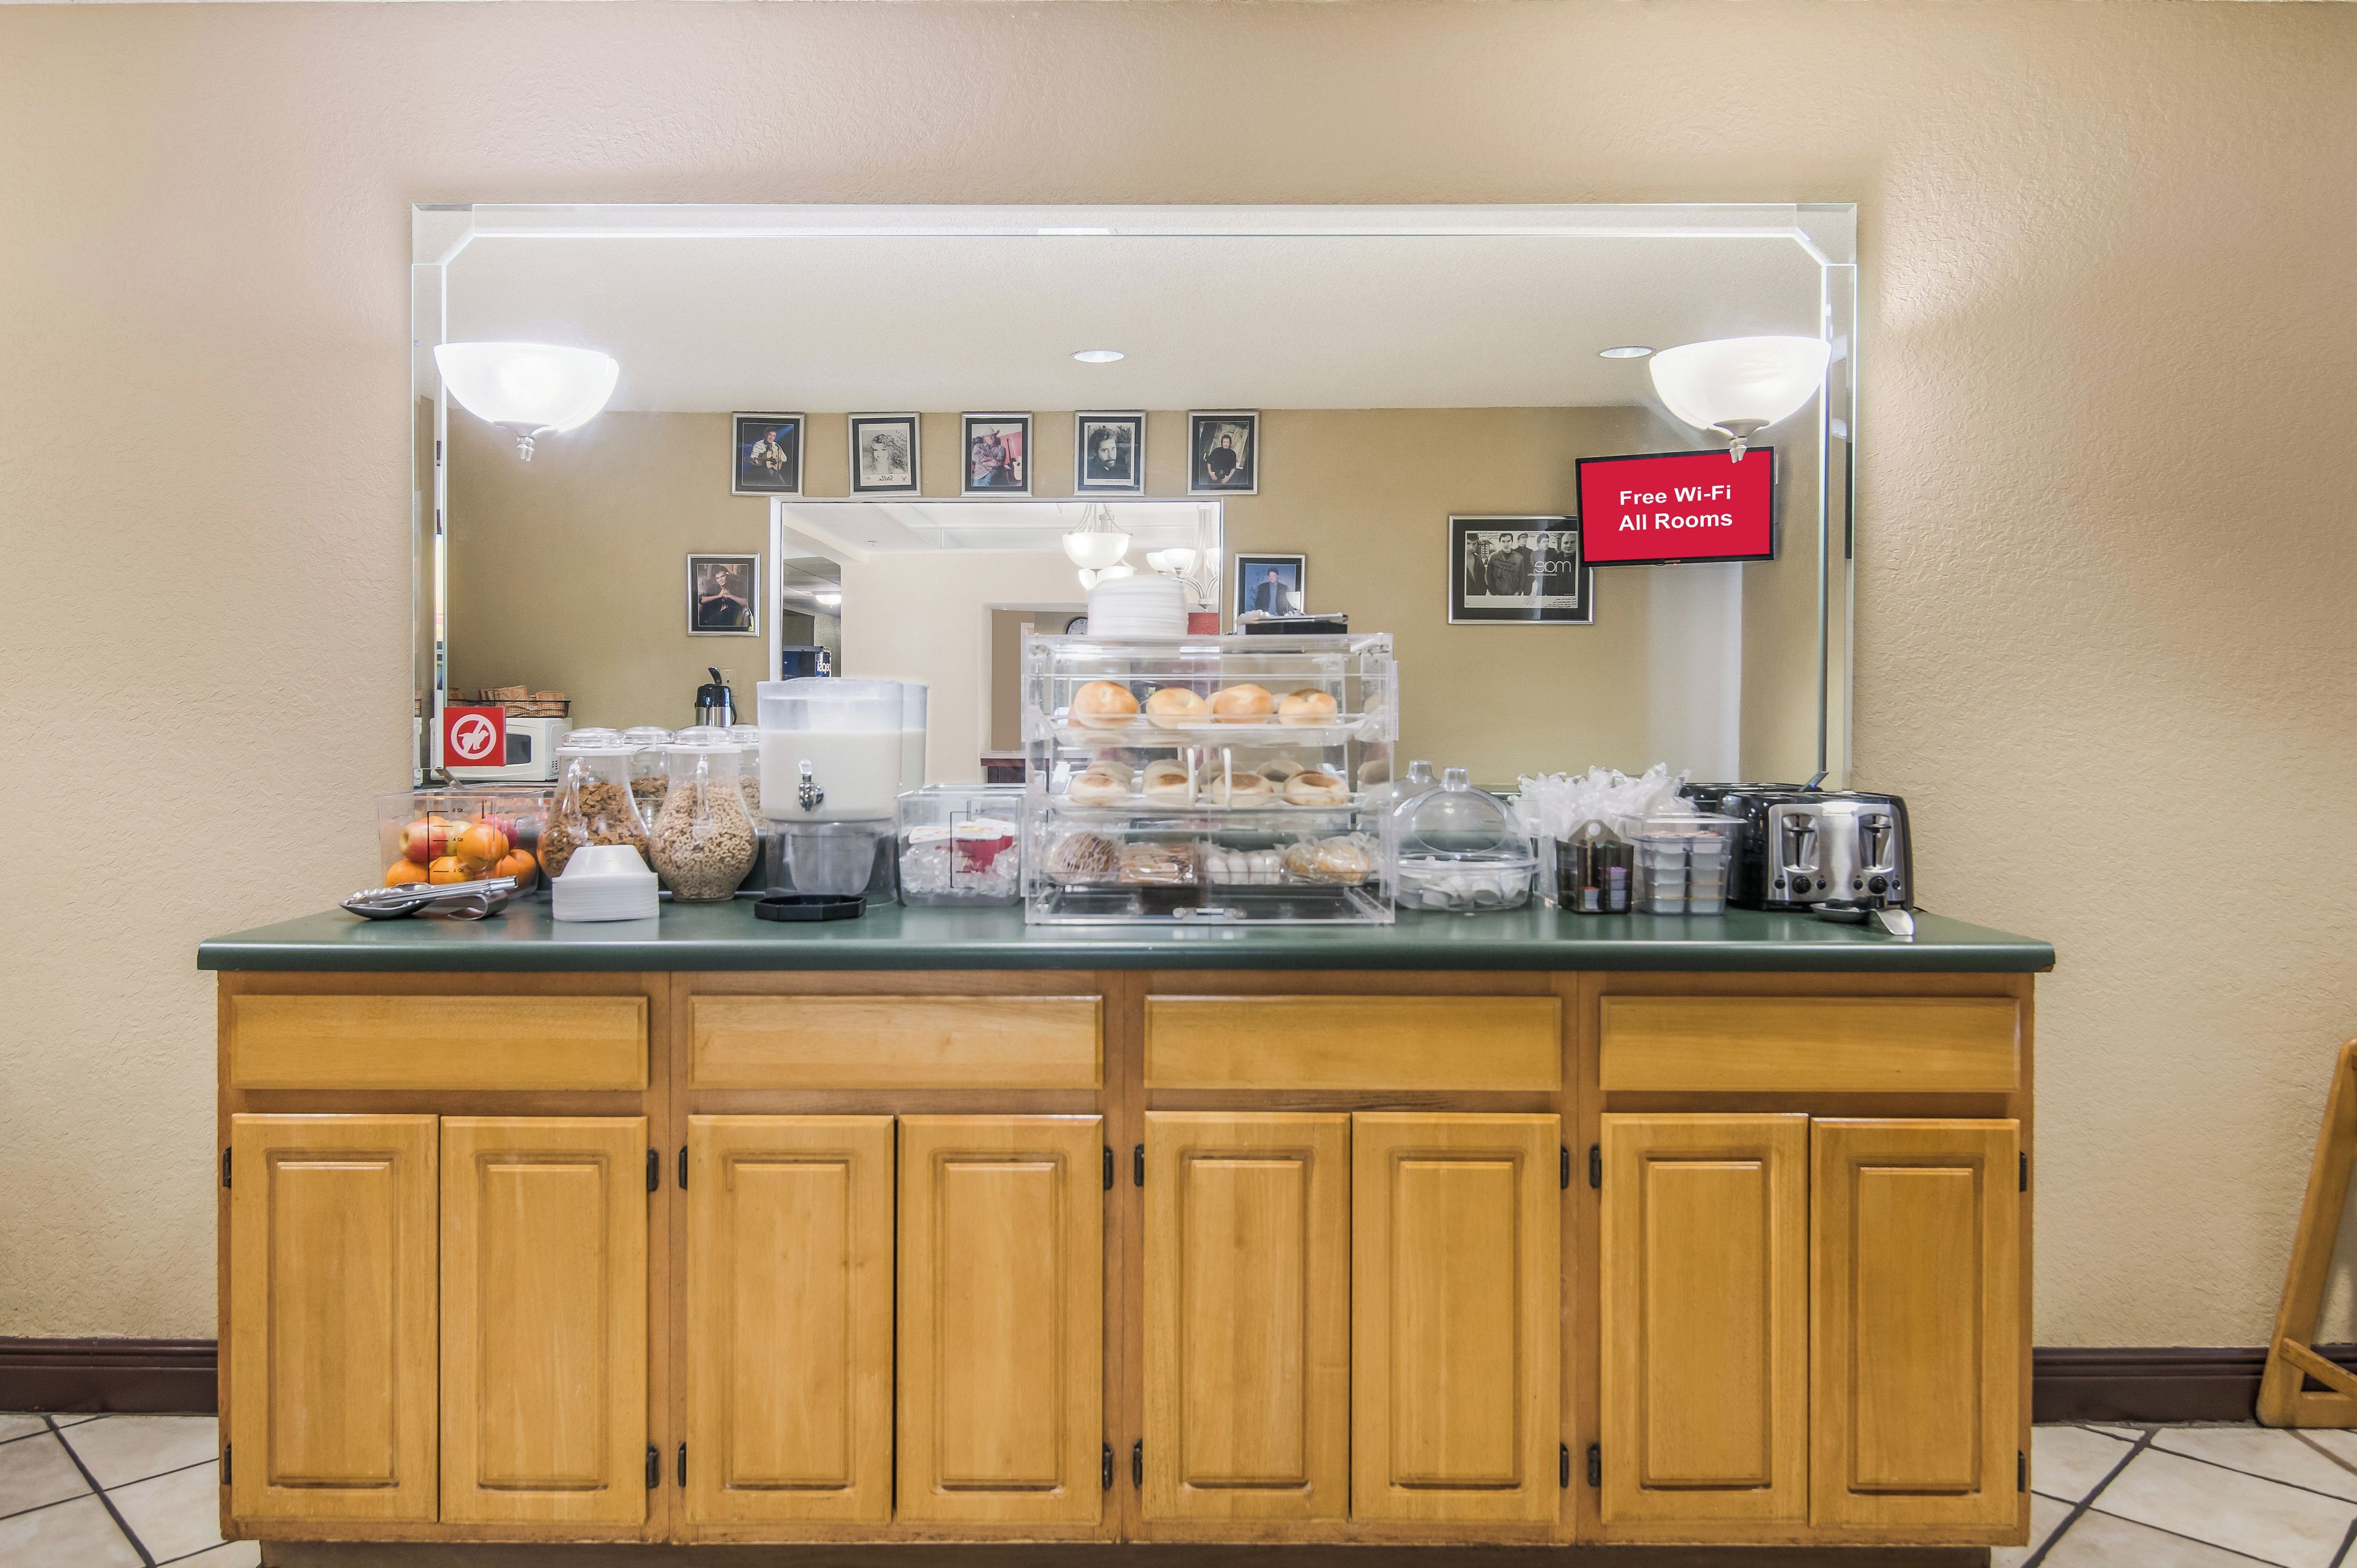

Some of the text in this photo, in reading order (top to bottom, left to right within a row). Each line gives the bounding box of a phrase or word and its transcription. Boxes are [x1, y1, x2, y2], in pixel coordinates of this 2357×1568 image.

[1620, 484, 1731, 506] Free Wi-Fi
[1619, 512, 1733, 531] All Rooms
